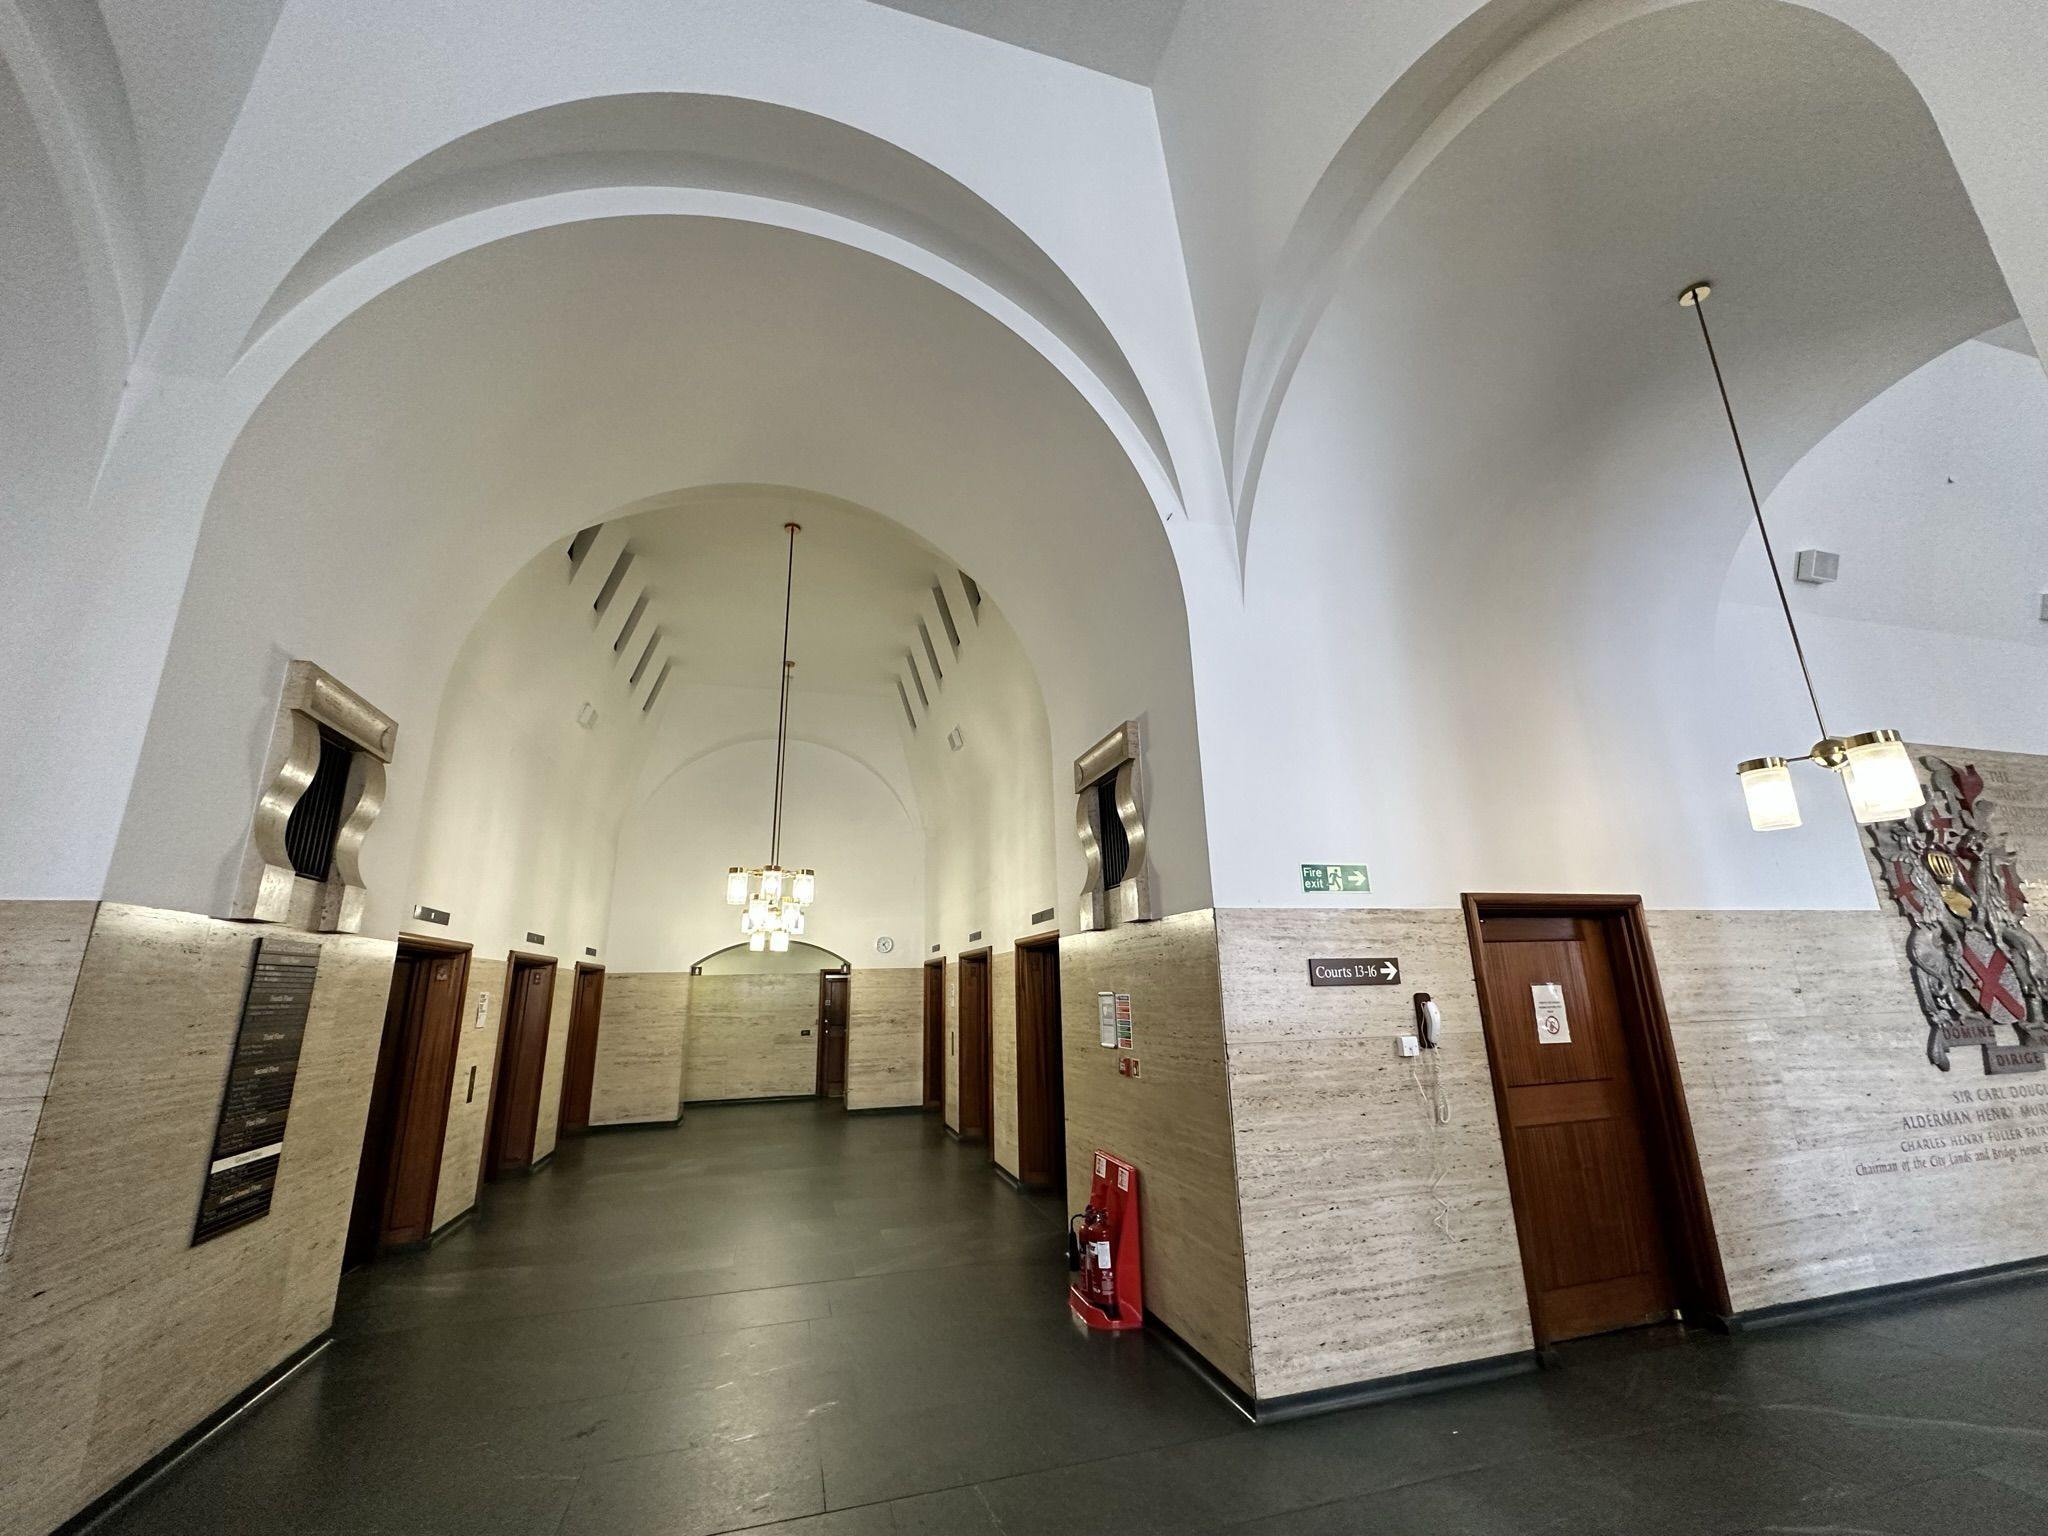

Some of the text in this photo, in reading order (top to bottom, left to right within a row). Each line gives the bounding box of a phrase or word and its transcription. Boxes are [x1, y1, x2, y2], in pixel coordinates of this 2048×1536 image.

[1303, 867, 1323, 878] Fire
[1304, 879, 1324, 889] exit
[1315, 965, 1378, 979] Courts 13-16
[1943, 1026, 1995, 1040] DOMINE
[1996, 1052, 2041, 1066] DIRIGE
[1952, 1089, 1973, 1104] SIR
[1977, 1087, 2006, 1102] CARL
[1902, 1110, 1972, 1130] ALDERMAN
[1900, 1138, 1946, 1152] CHARLES
[1950, 1134, 1984, 1147] HENRY
[1988, 1129, 2022, 1142] FULLER
[1855, 1163, 1898, 1176] Chairman
[1902, 1160, 1910, 1172] of
[1914, 1156, 1927, 1169] the
[1930, 1155, 1946, 1168] City
[1949, 1152, 1971, 1166] Lands
[1975, 1148, 1990, 1161] and
